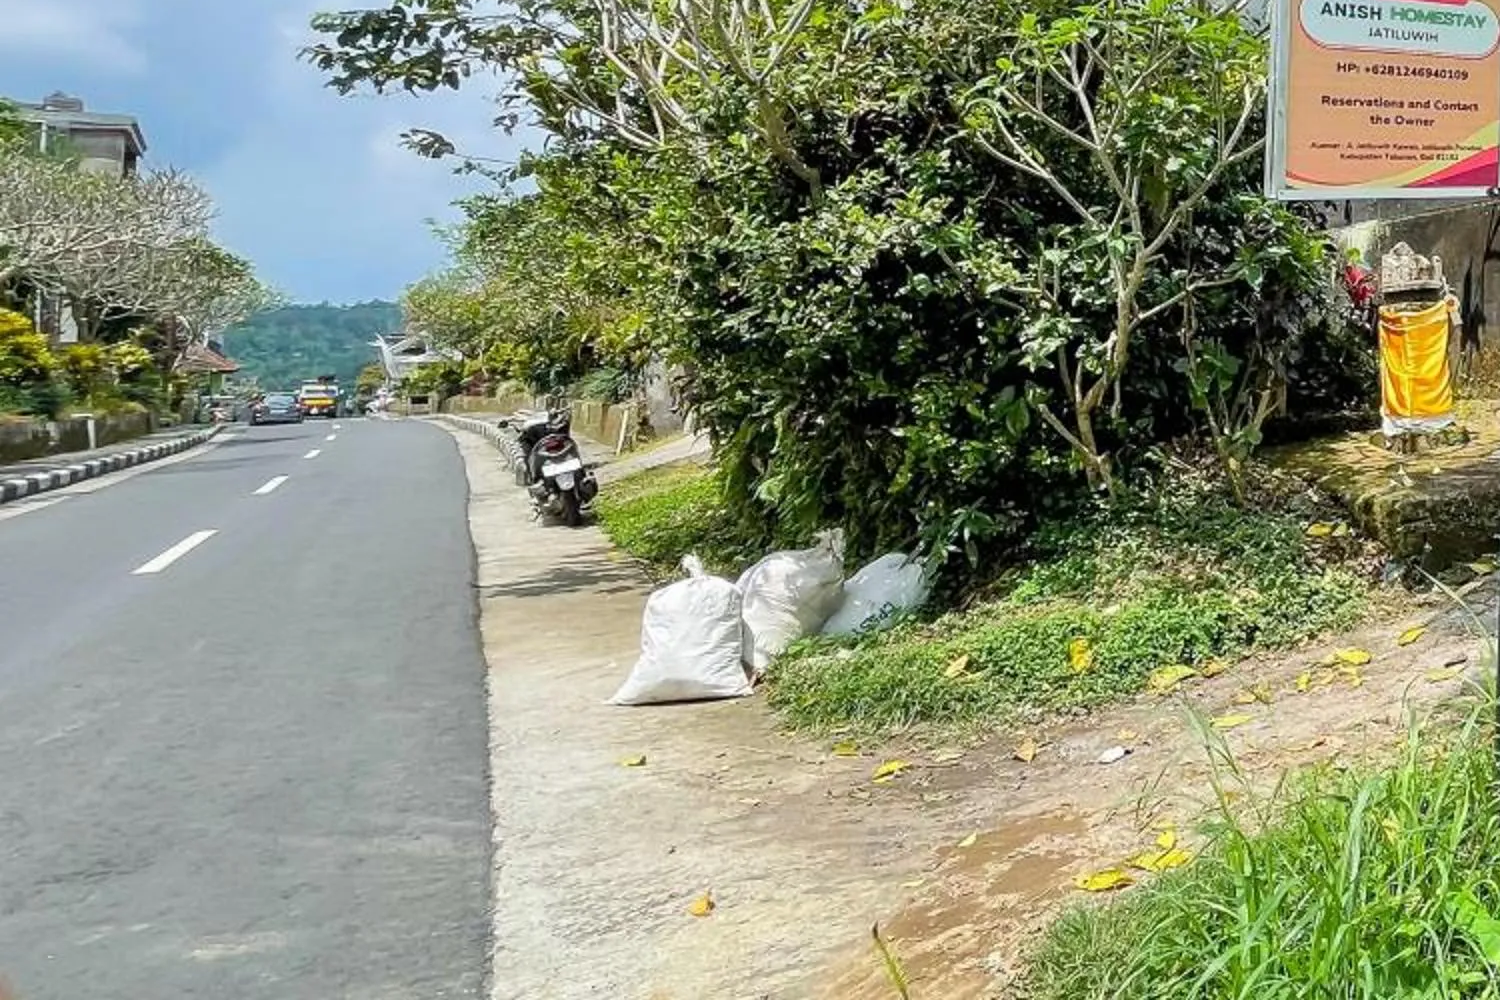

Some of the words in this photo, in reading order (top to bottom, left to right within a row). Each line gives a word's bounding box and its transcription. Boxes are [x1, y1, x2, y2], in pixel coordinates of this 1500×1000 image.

[1321, 1, 1383, 21] ANISH
[1390, 5, 1487, 29] HOMESTAY
[1368, 26, 1439, 42] JATILUWIH
[1321, 95, 1405, 109] Reservations
[1408, 100, 1431, 109] and
[1369, 114, 1391, 125] the
[1395, 115, 1436, 127] Owner
